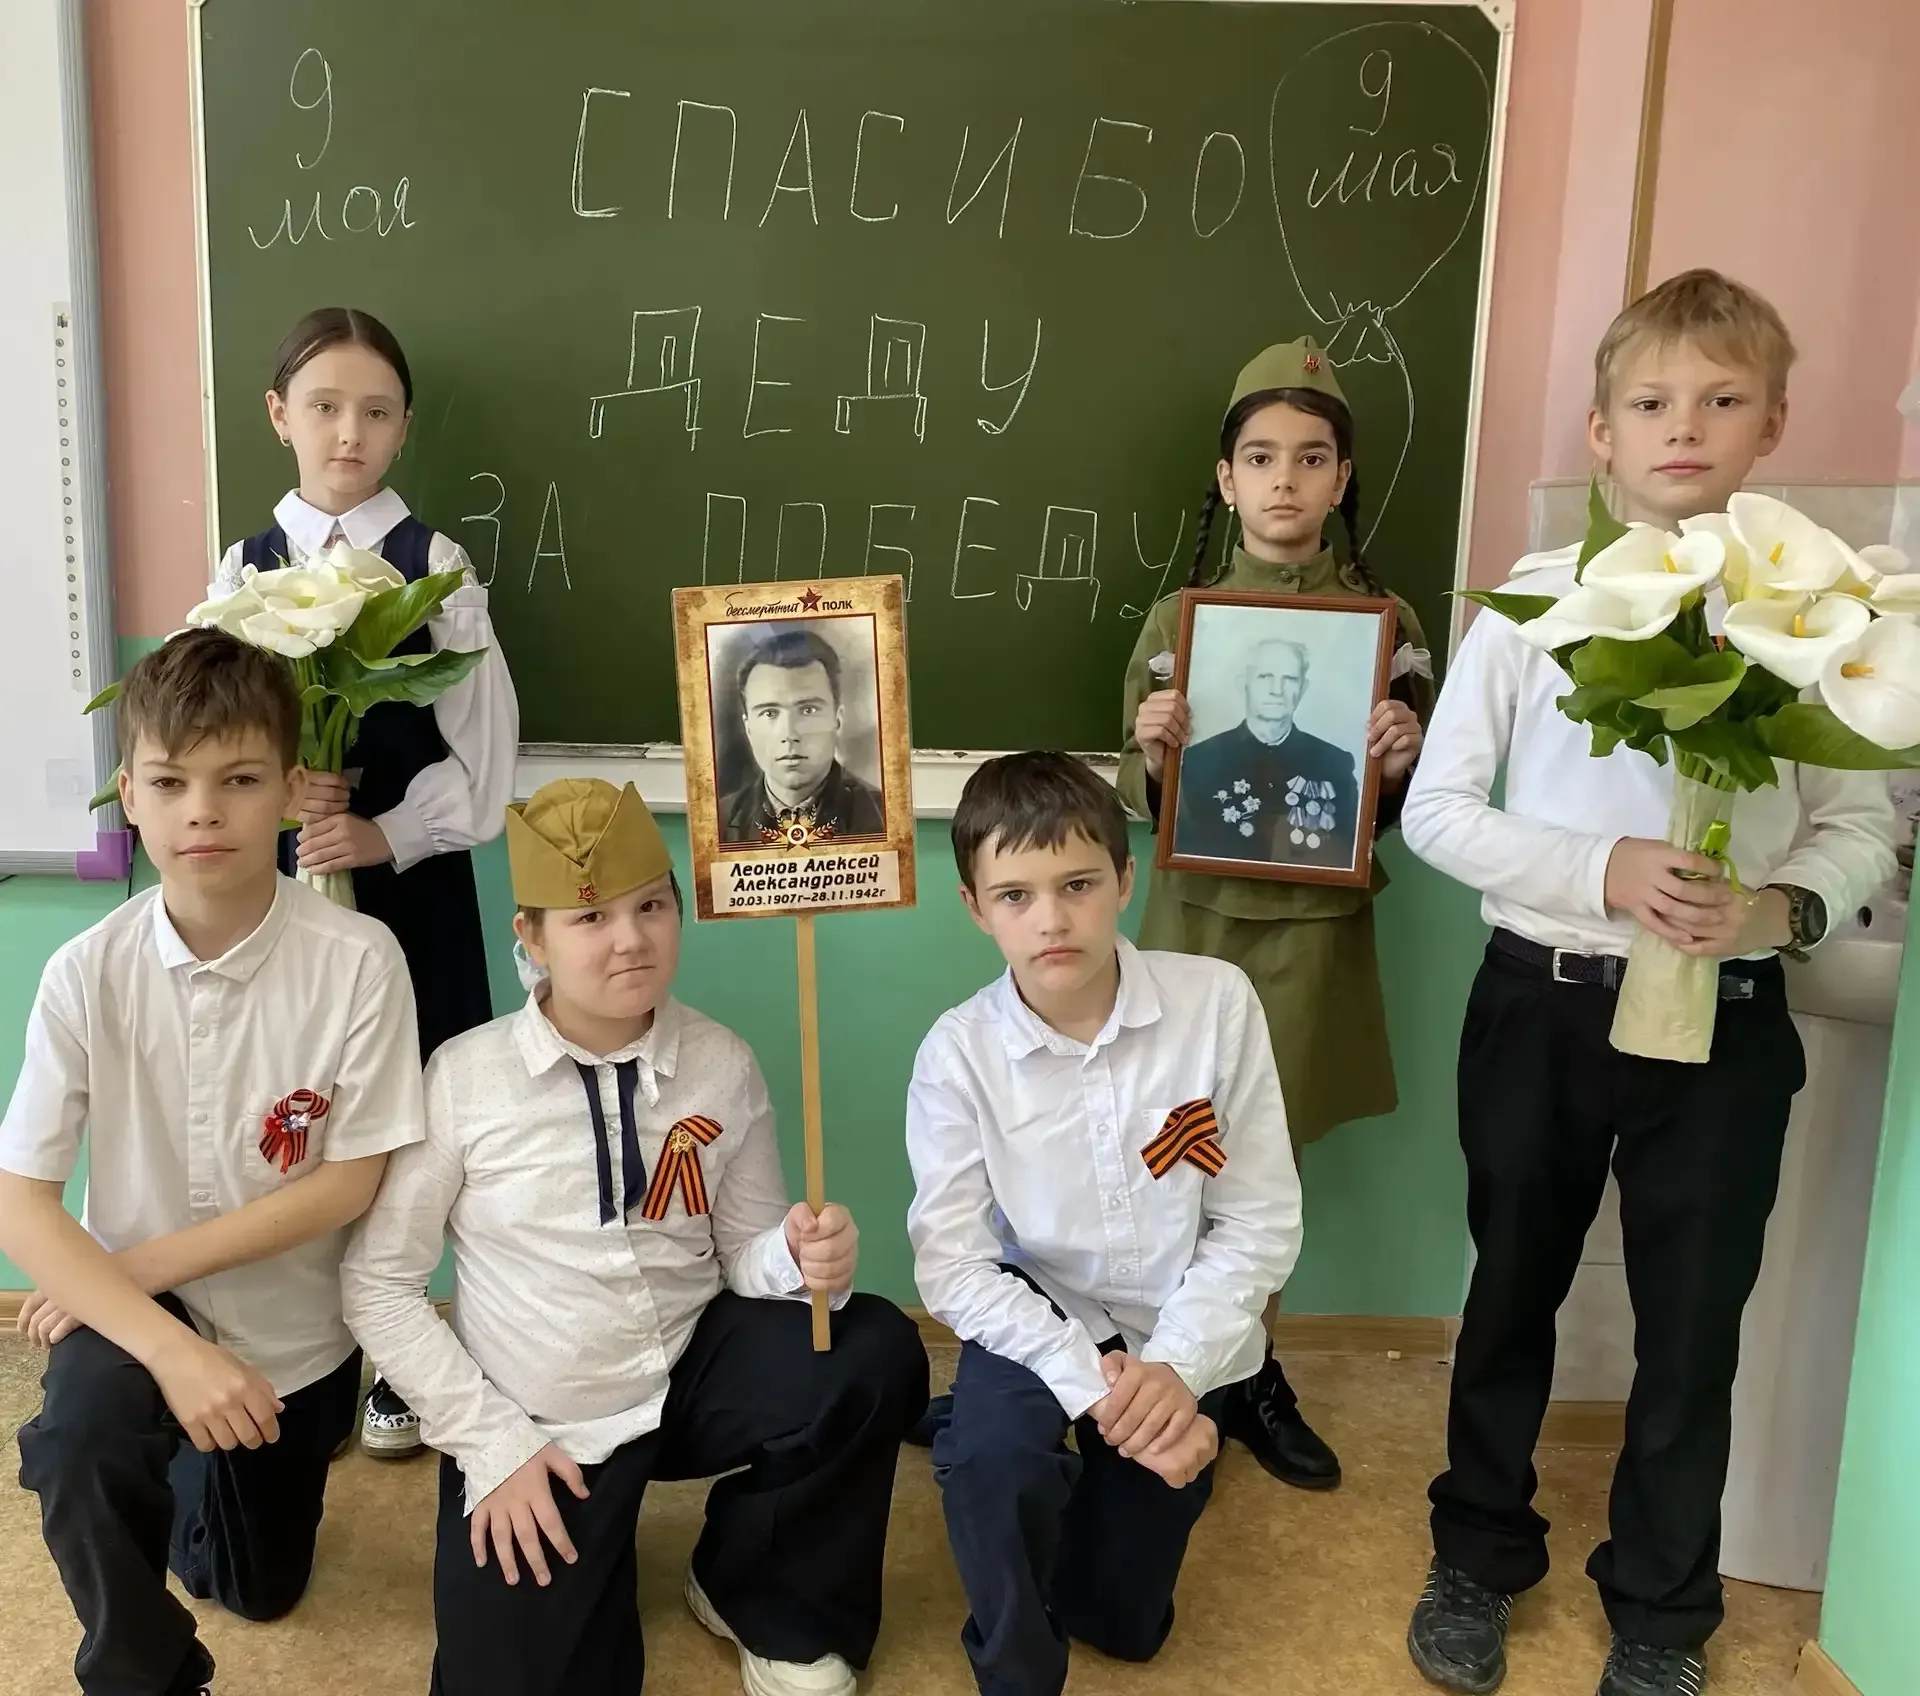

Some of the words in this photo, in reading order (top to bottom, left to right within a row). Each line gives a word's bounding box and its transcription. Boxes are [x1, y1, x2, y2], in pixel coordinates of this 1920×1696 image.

[290, 47, 333, 169] 9
[1349, 49, 1392, 136] 9
[570, 86, 1246, 239] СПАСИБО
[1308, 142, 1464, 208] мая
[589, 305, 1042, 451] ДЕДУ
[461, 472, 572, 593] ЗА
[730, 861, 798, 877] Леонов
[803, 854, 880, 873] Алексей
[733, 871, 879, 893] Александрович
